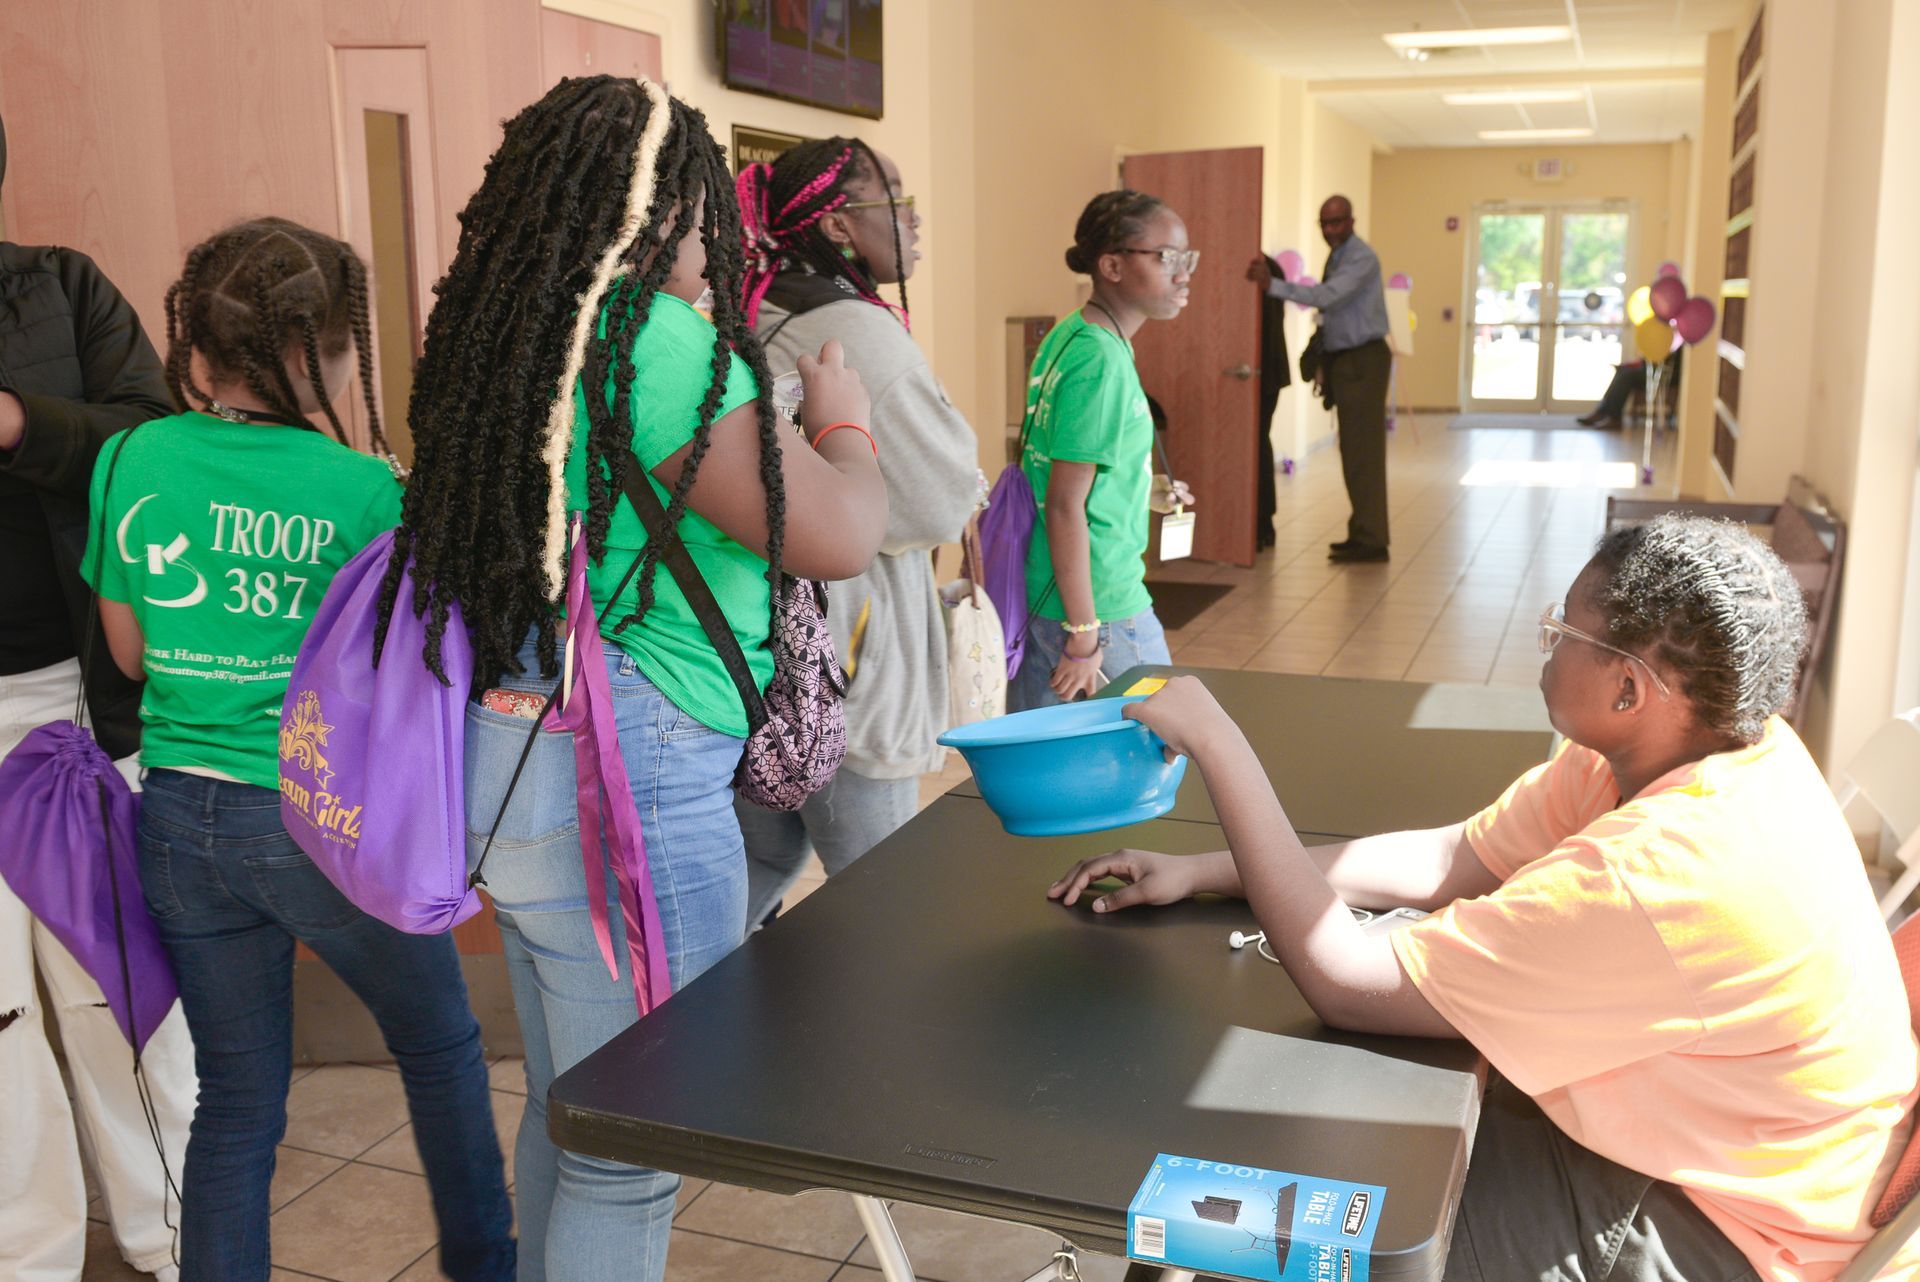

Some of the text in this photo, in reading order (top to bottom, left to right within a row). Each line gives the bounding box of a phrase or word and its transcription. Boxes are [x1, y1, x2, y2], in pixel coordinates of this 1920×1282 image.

[208, 500, 336, 565] TROOP
[223, 567, 309, 619] 387
[174, 648, 213, 663] HARD
[215, 655, 235, 666] TO
[235, 655, 270, 668] PLAY
[313, 791, 363, 839] Girls
[1167, 1157, 1271, 1181] 6-FOOT
[1303, 1191, 1331, 1225] TABLE
[1345, 1195, 1367, 1232] LIFETIME
